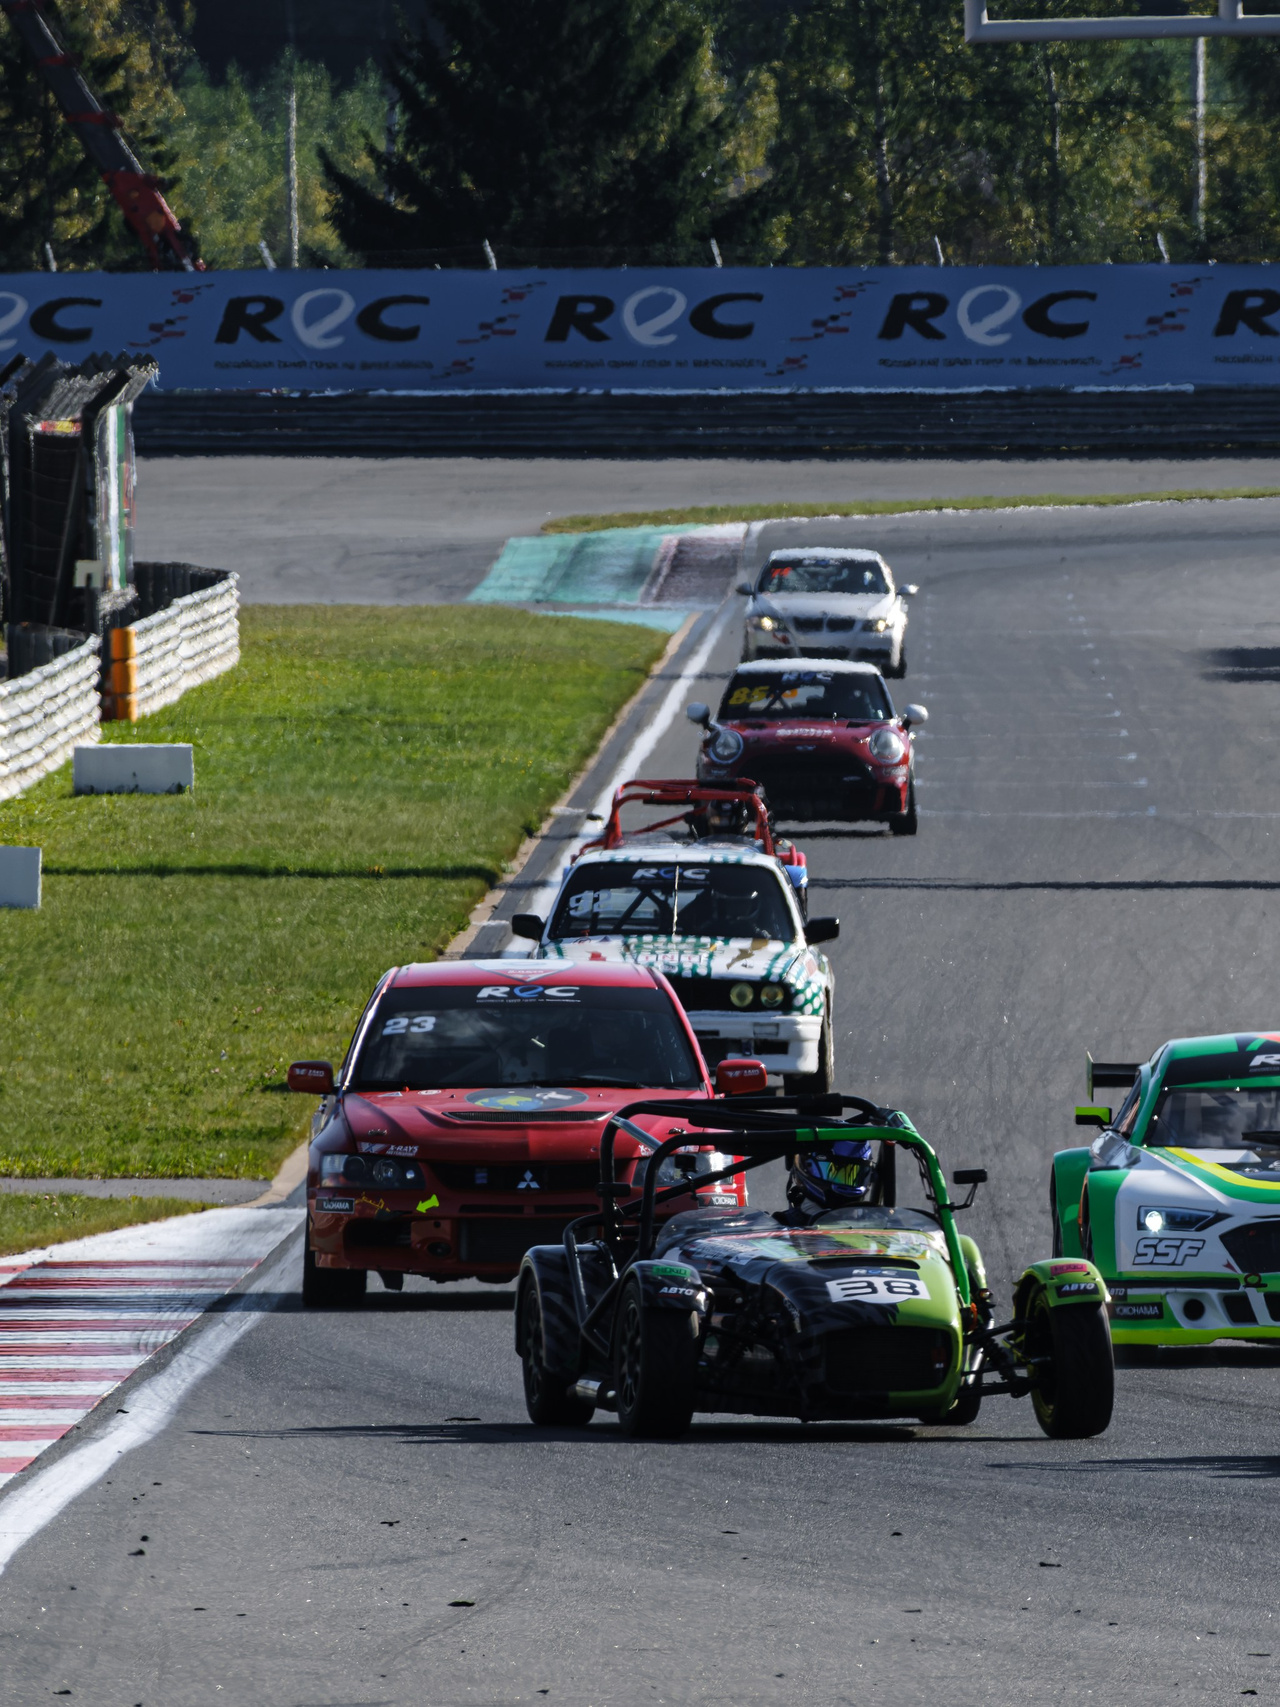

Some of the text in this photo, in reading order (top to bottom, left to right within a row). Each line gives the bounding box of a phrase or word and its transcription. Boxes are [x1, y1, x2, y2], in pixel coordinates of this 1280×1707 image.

[728, 686, 770, 705] 85
[569, 889, 612, 918] 92
[382, 1016, 436, 1036] 23
[711, 1197, 737, 1206] YOKOHAMA
[1132, 1237, 1206, 1266] SSF
[836, 1280, 921, 1298] 38
[1115, 1305, 1159, 1316] YOKOHAMA
